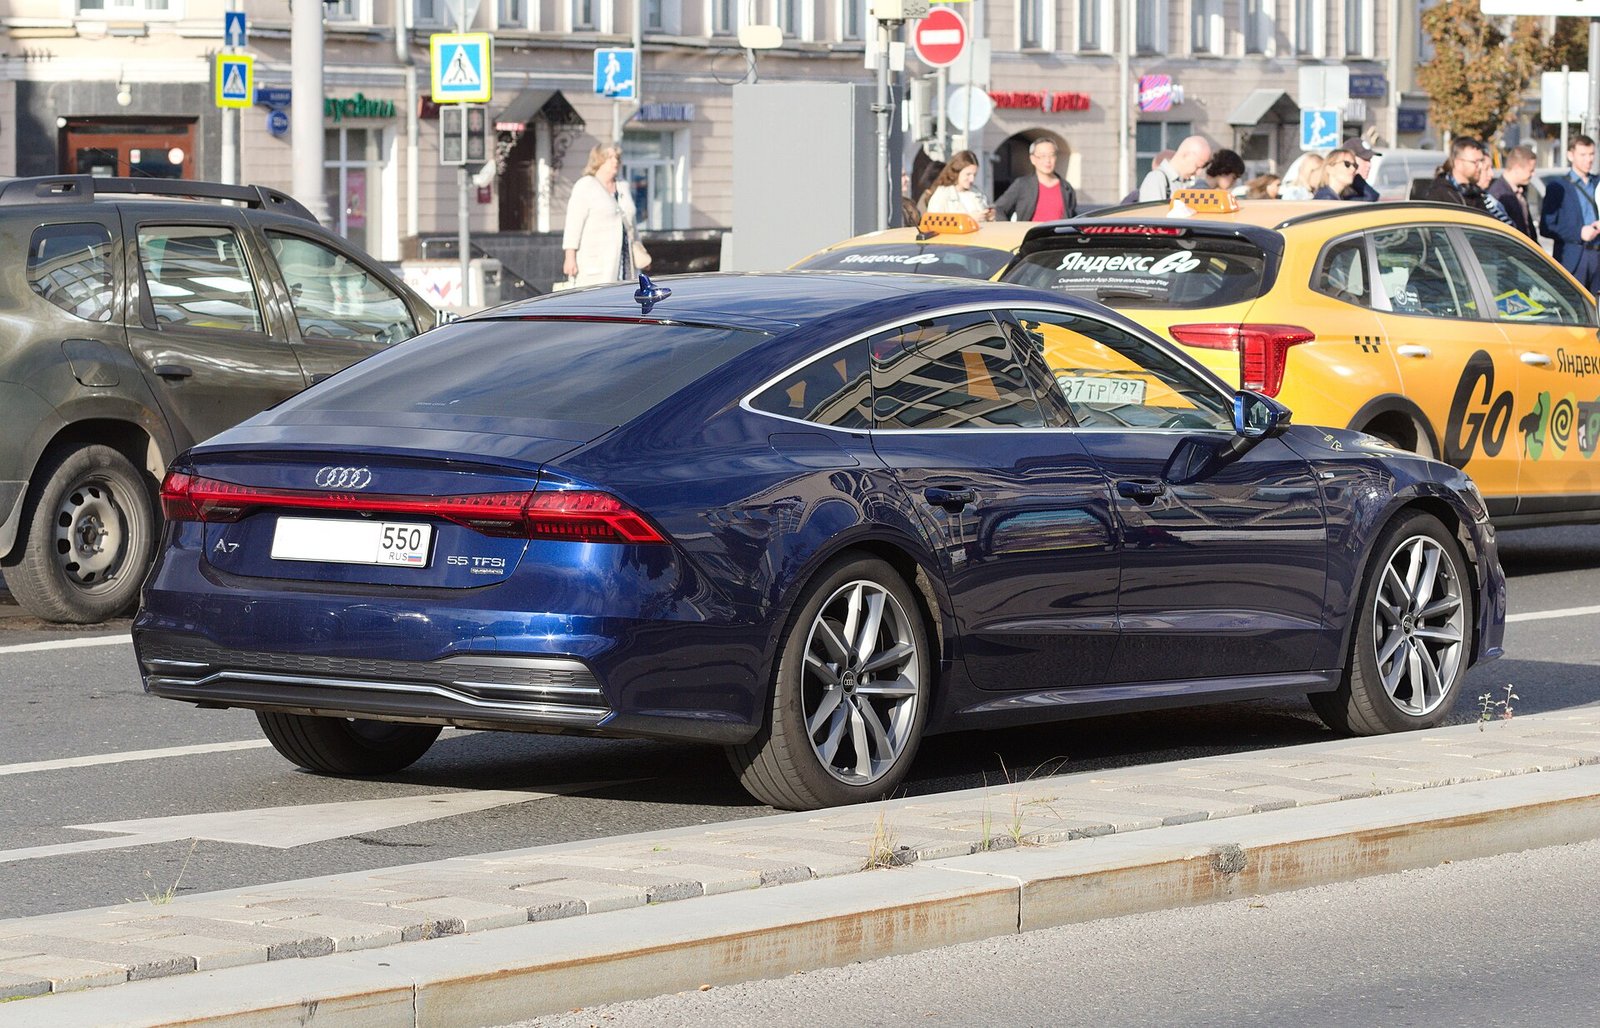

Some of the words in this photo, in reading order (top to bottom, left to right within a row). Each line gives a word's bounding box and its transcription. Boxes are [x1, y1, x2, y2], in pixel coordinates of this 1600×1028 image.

[1056, 251, 1154, 273] Яндекс
[1149, 250, 1201, 275] Go
[1556, 348, 1600, 378] Яндек
[1112, 381, 1137, 395] 797
[1443, 349, 1514, 471] Go
[213, 538, 240, 553] A7
[382, 526, 421, 551] 550
[388, 552, 408, 561] RUS
[446, 555, 469, 566] 55
[471, 556, 506, 567] TFSI
